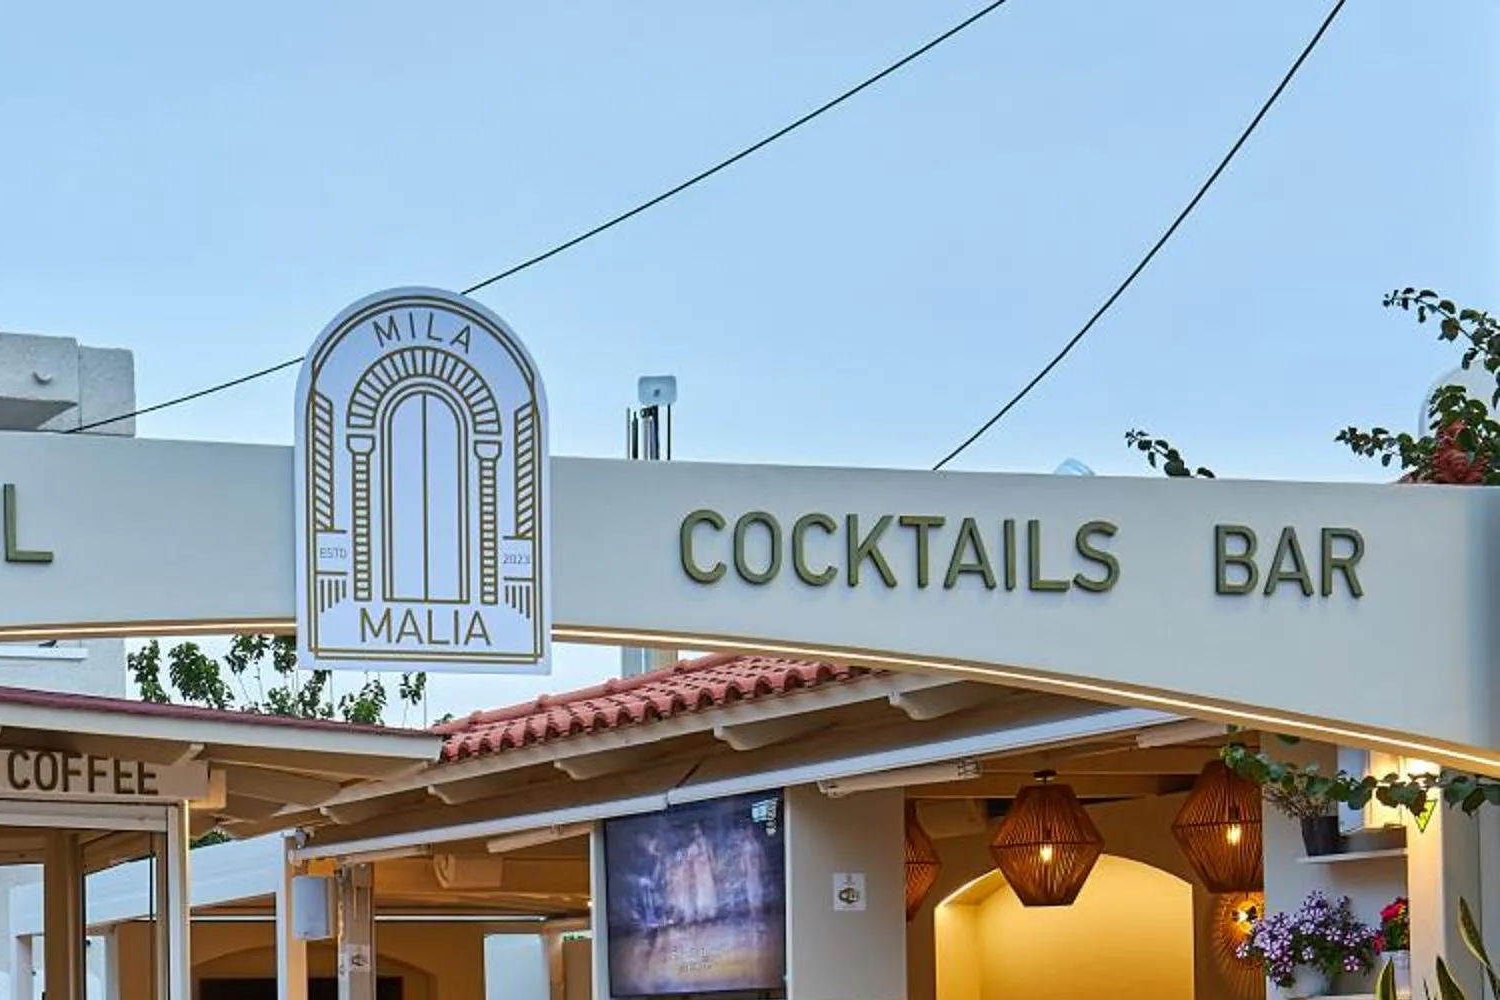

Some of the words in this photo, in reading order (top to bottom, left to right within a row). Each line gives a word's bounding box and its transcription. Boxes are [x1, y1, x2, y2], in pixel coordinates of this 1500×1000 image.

[372, 311, 474, 354] MILA
[319, 547, 348, 559] ESTD
[679, 508, 1122, 594] COCKTAILS
[1214, 523, 1366, 598] BAR
[359, 607, 492, 647] MALIA
[7, 748, 160, 796] COFFEE
